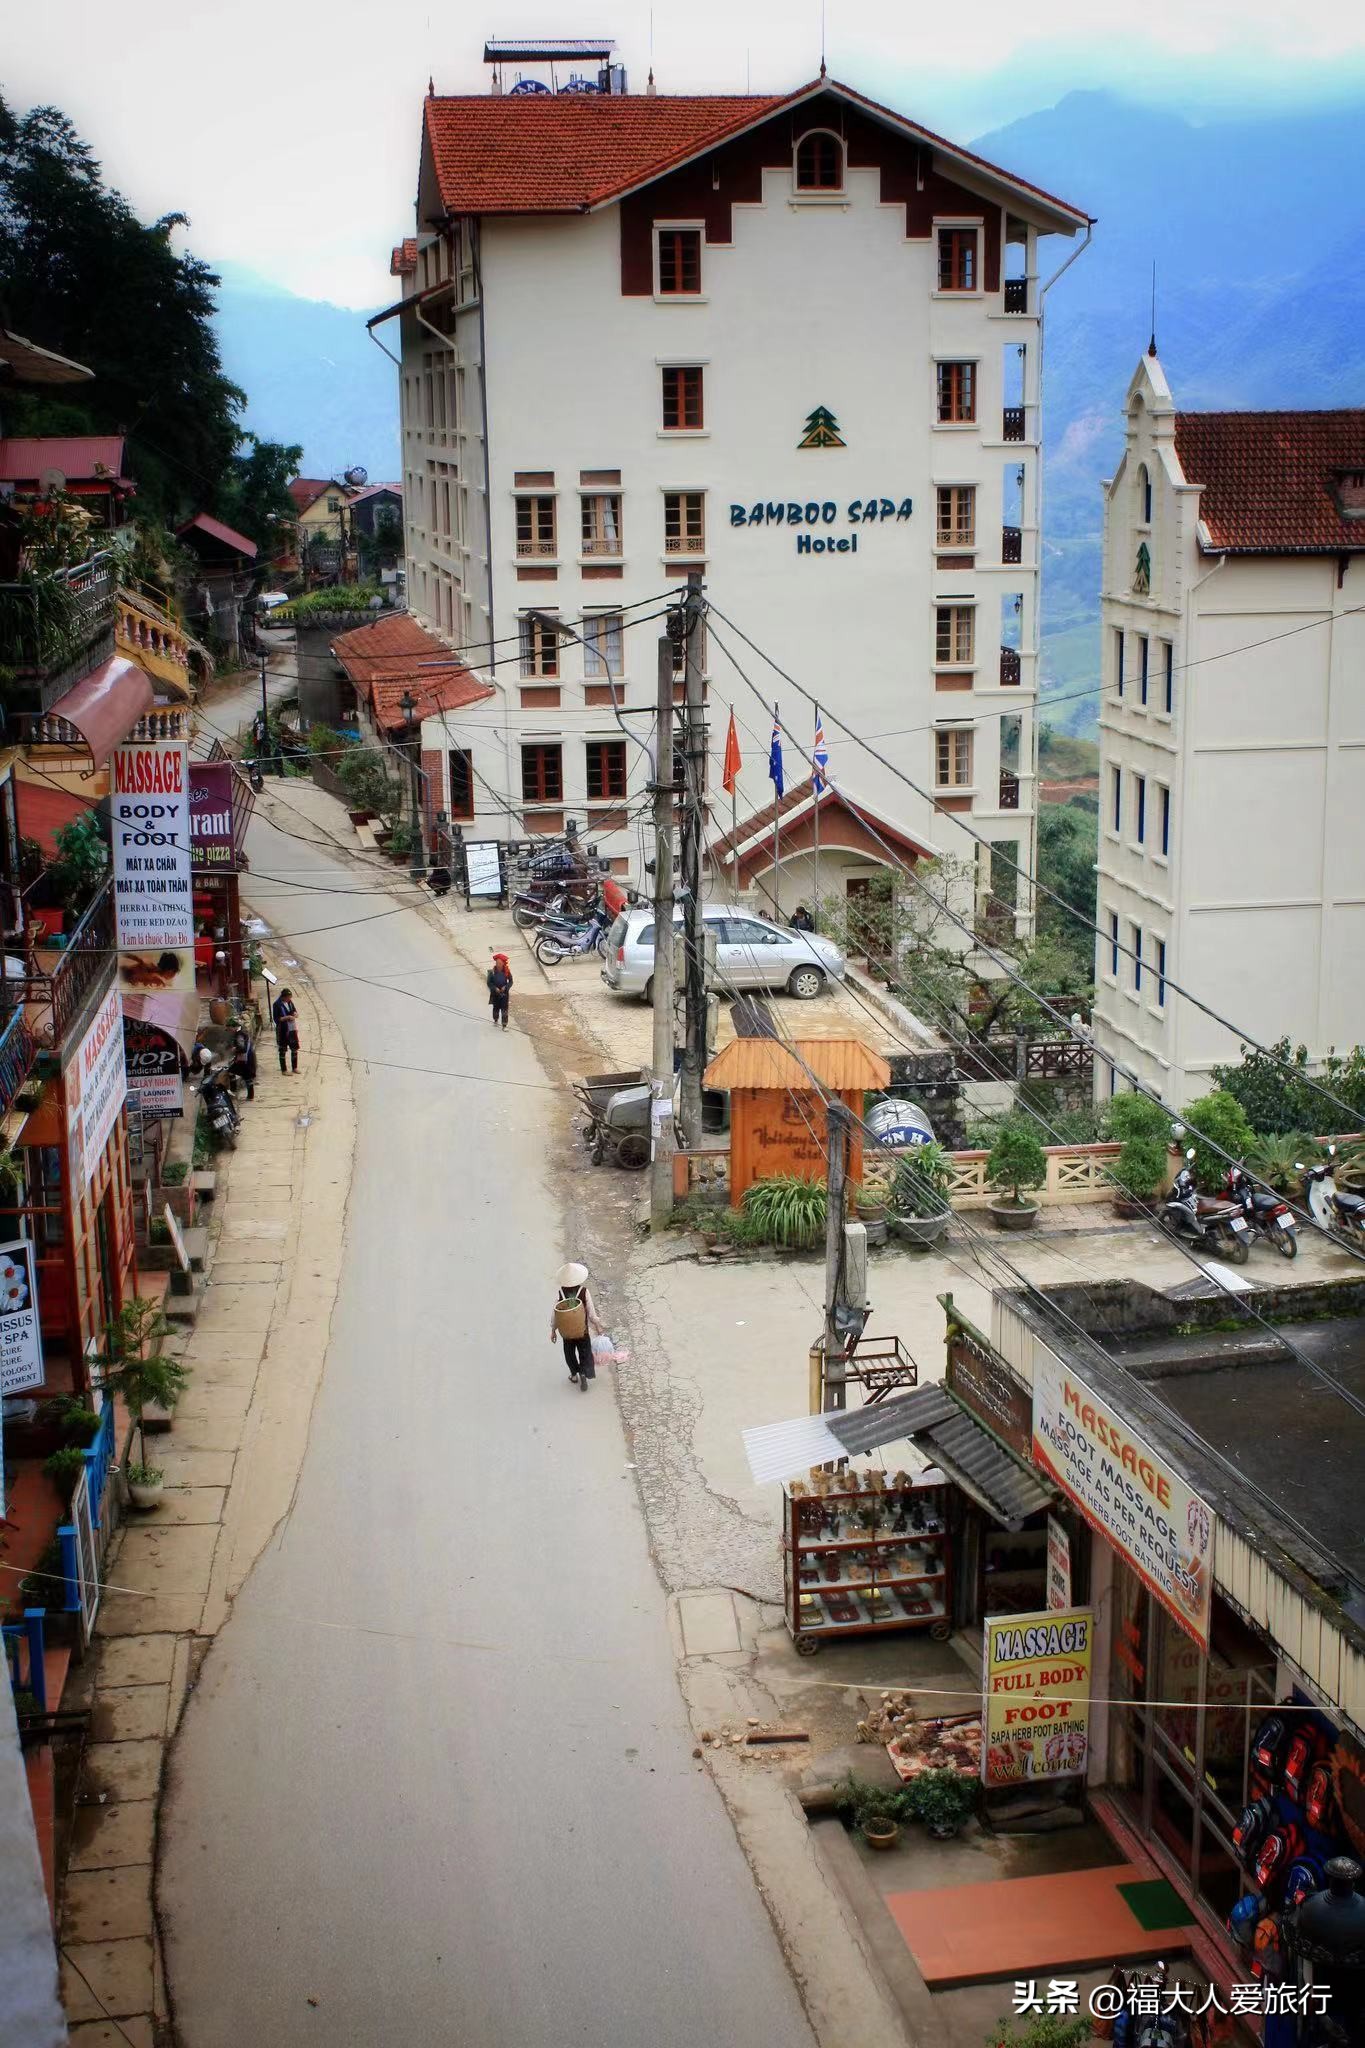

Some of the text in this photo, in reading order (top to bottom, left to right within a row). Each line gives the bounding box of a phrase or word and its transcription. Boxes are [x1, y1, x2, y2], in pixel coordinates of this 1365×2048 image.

[730, 498, 913, 527] BAMBOO SAPA
[797, 533, 857, 554] Hotel
[114, 750, 182, 794] MASSAGE
[120, 805, 179, 819] BODY
[144, 820, 155, 830] &
[122, 832, 179, 846] FOOT
[144, 857, 155, 871] XA
[207, 843, 231, 866] pizza
[134, 879, 146, 893] XA
[120, 903, 186, 913] HERBAL BATHING
[121, 919, 132, 927] OF
[133, 919, 148, 927] THE
[149, 919, 165, 927] RED
[143, 1089, 176, 1097] LAUNDRY
[5, 1330, 29, 1345] SPA
[1061, 1380, 1172, 1509] MASSAGE
[1059, 1412, 1096, 1461] FOOT
[1101, 1457, 1177, 1548] MASSAGE
[1041, 1417, 1092, 1484] MASSAGE
[1095, 1479, 1110, 1503] AS
[1114, 1497, 1136, 1531] PER
[1140, 1527, 1198, 1598] REQUEST
[1066, 1468, 1086, 1498] SAPA
[1087, 1492, 1110, 1523] HERB
[1110, 1517, 1133, 1548] FOOT
[1134, 1543, 1173, 1593] BATHING
[994, 1622, 1087, 1663] MASSAGE
[993, 1666, 1086, 1693] FULL BODY
[1004, 1701, 1073, 1724] FOOT
[991, 1719, 1085, 1744] SAPA HERB FOOT BATHING
